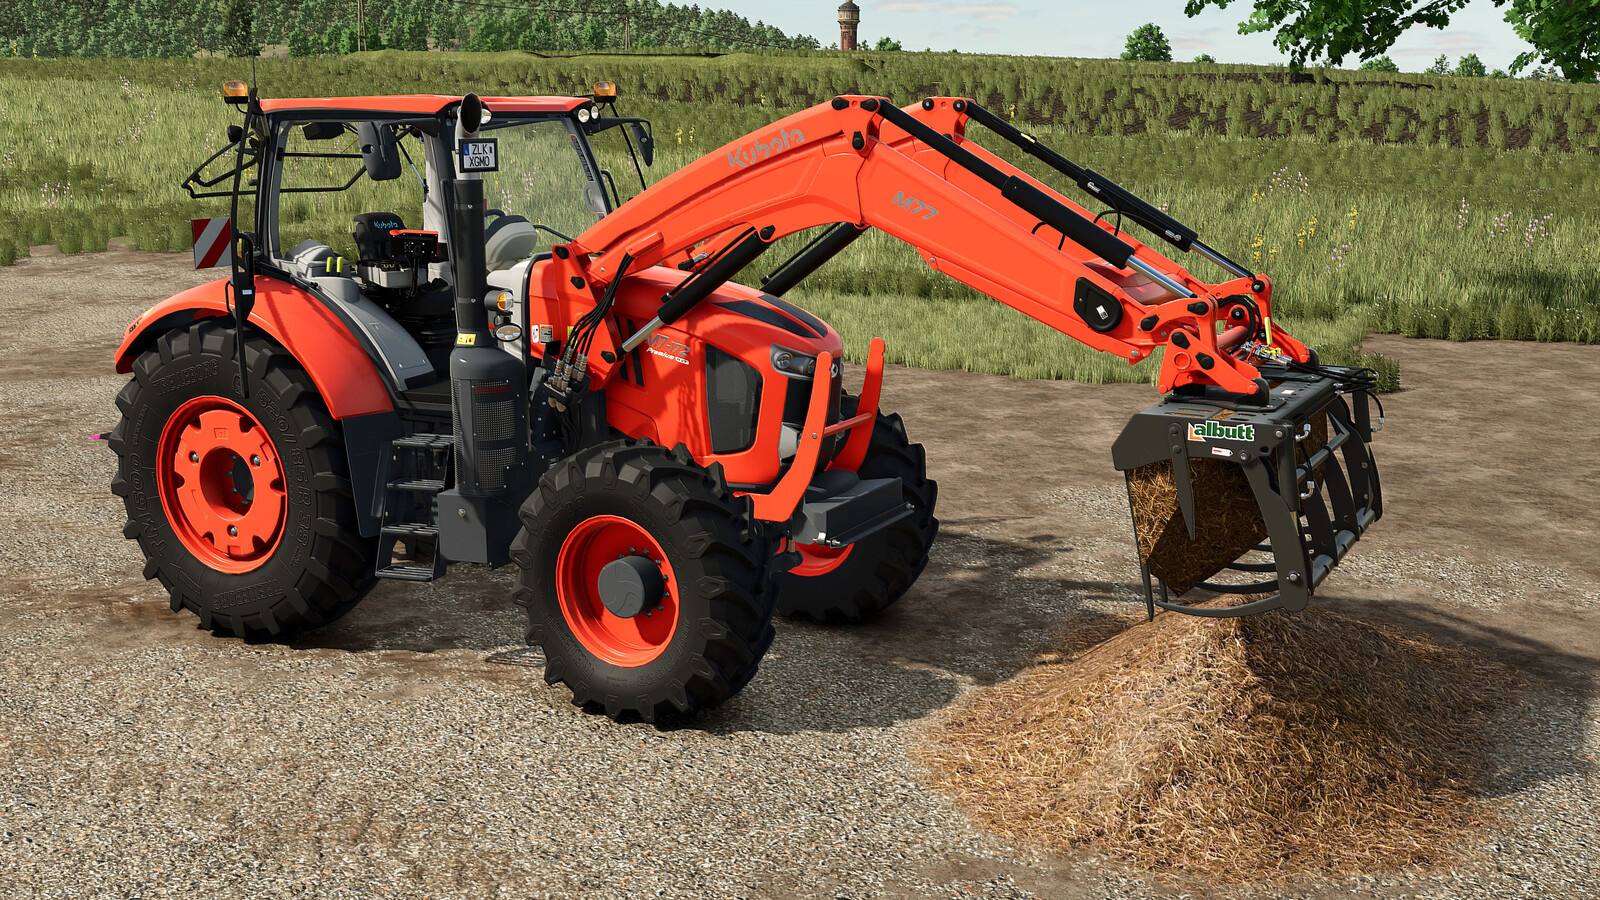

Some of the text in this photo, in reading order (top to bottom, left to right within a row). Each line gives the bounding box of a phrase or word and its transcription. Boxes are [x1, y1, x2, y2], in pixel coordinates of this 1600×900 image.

[472, 144, 488, 155] ZLK
[727, 128, 805, 168] Kubota
[892, 191, 939, 220] M77
[373, 220, 398, 229] Kubota
[644, 333, 691, 357] M7-172
[646, 347, 675, 360] Premium
[152, 358, 220, 396] TRELLEBORG
[1194, 421, 1254, 440] albutt
